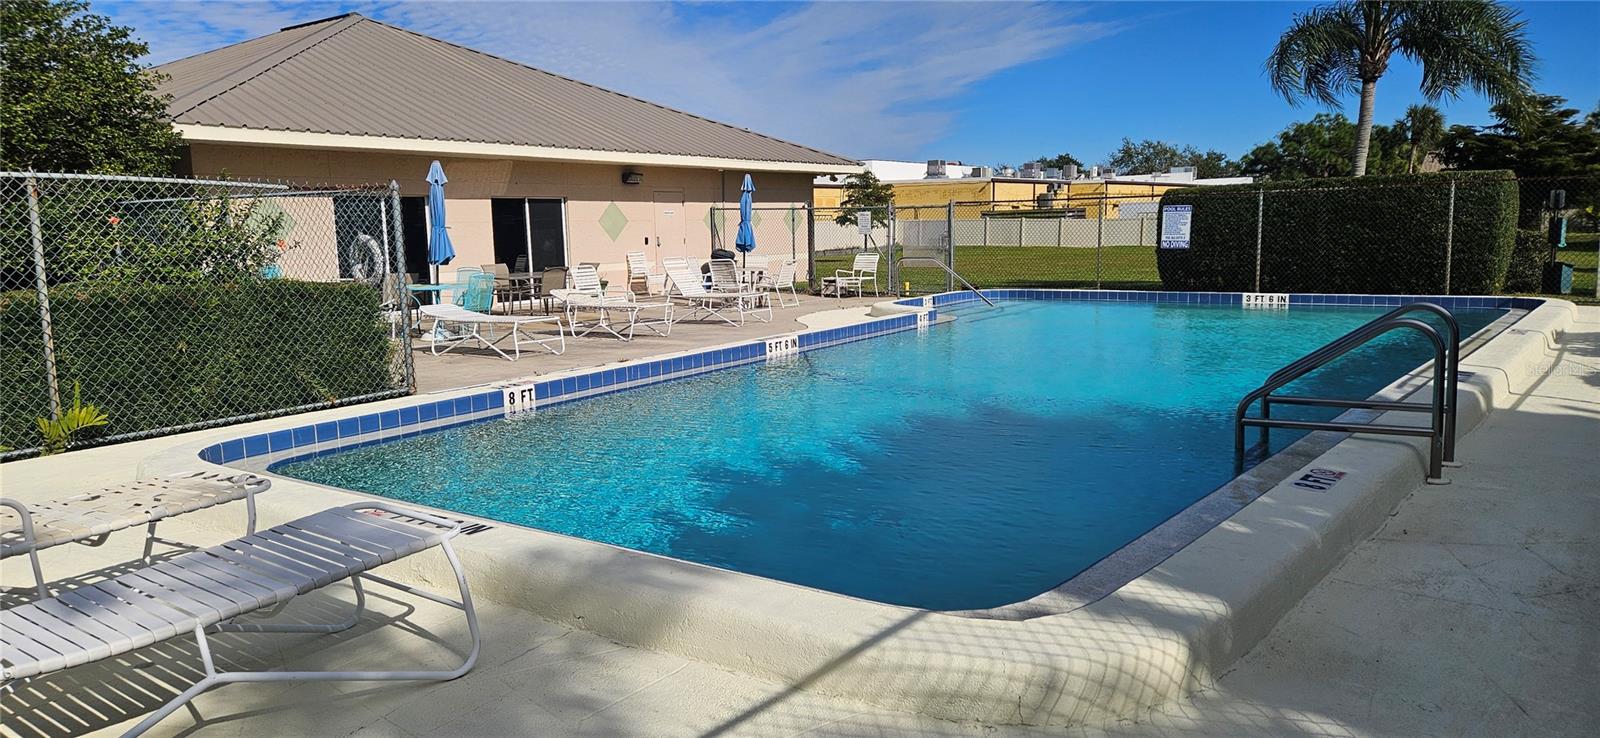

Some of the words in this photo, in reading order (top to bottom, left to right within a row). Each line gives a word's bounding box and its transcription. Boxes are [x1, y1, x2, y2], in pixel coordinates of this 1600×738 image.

[1246, 294, 1251, 303] 3
[1255, 295, 1265, 303] FT
[1268, 295, 1274, 303] 6
[1277, 295, 1287, 303] IN
[768, 342, 773, 353] 5
[775, 340, 782, 351] FT
[785, 339, 789, 350] 6
[790, 338, 797, 349] IN
[508, 391, 516, 405] 8
[520, 388, 533, 403] FT
[1293, 482, 1327, 490] 8
[1299, 473, 1337, 486] FT
